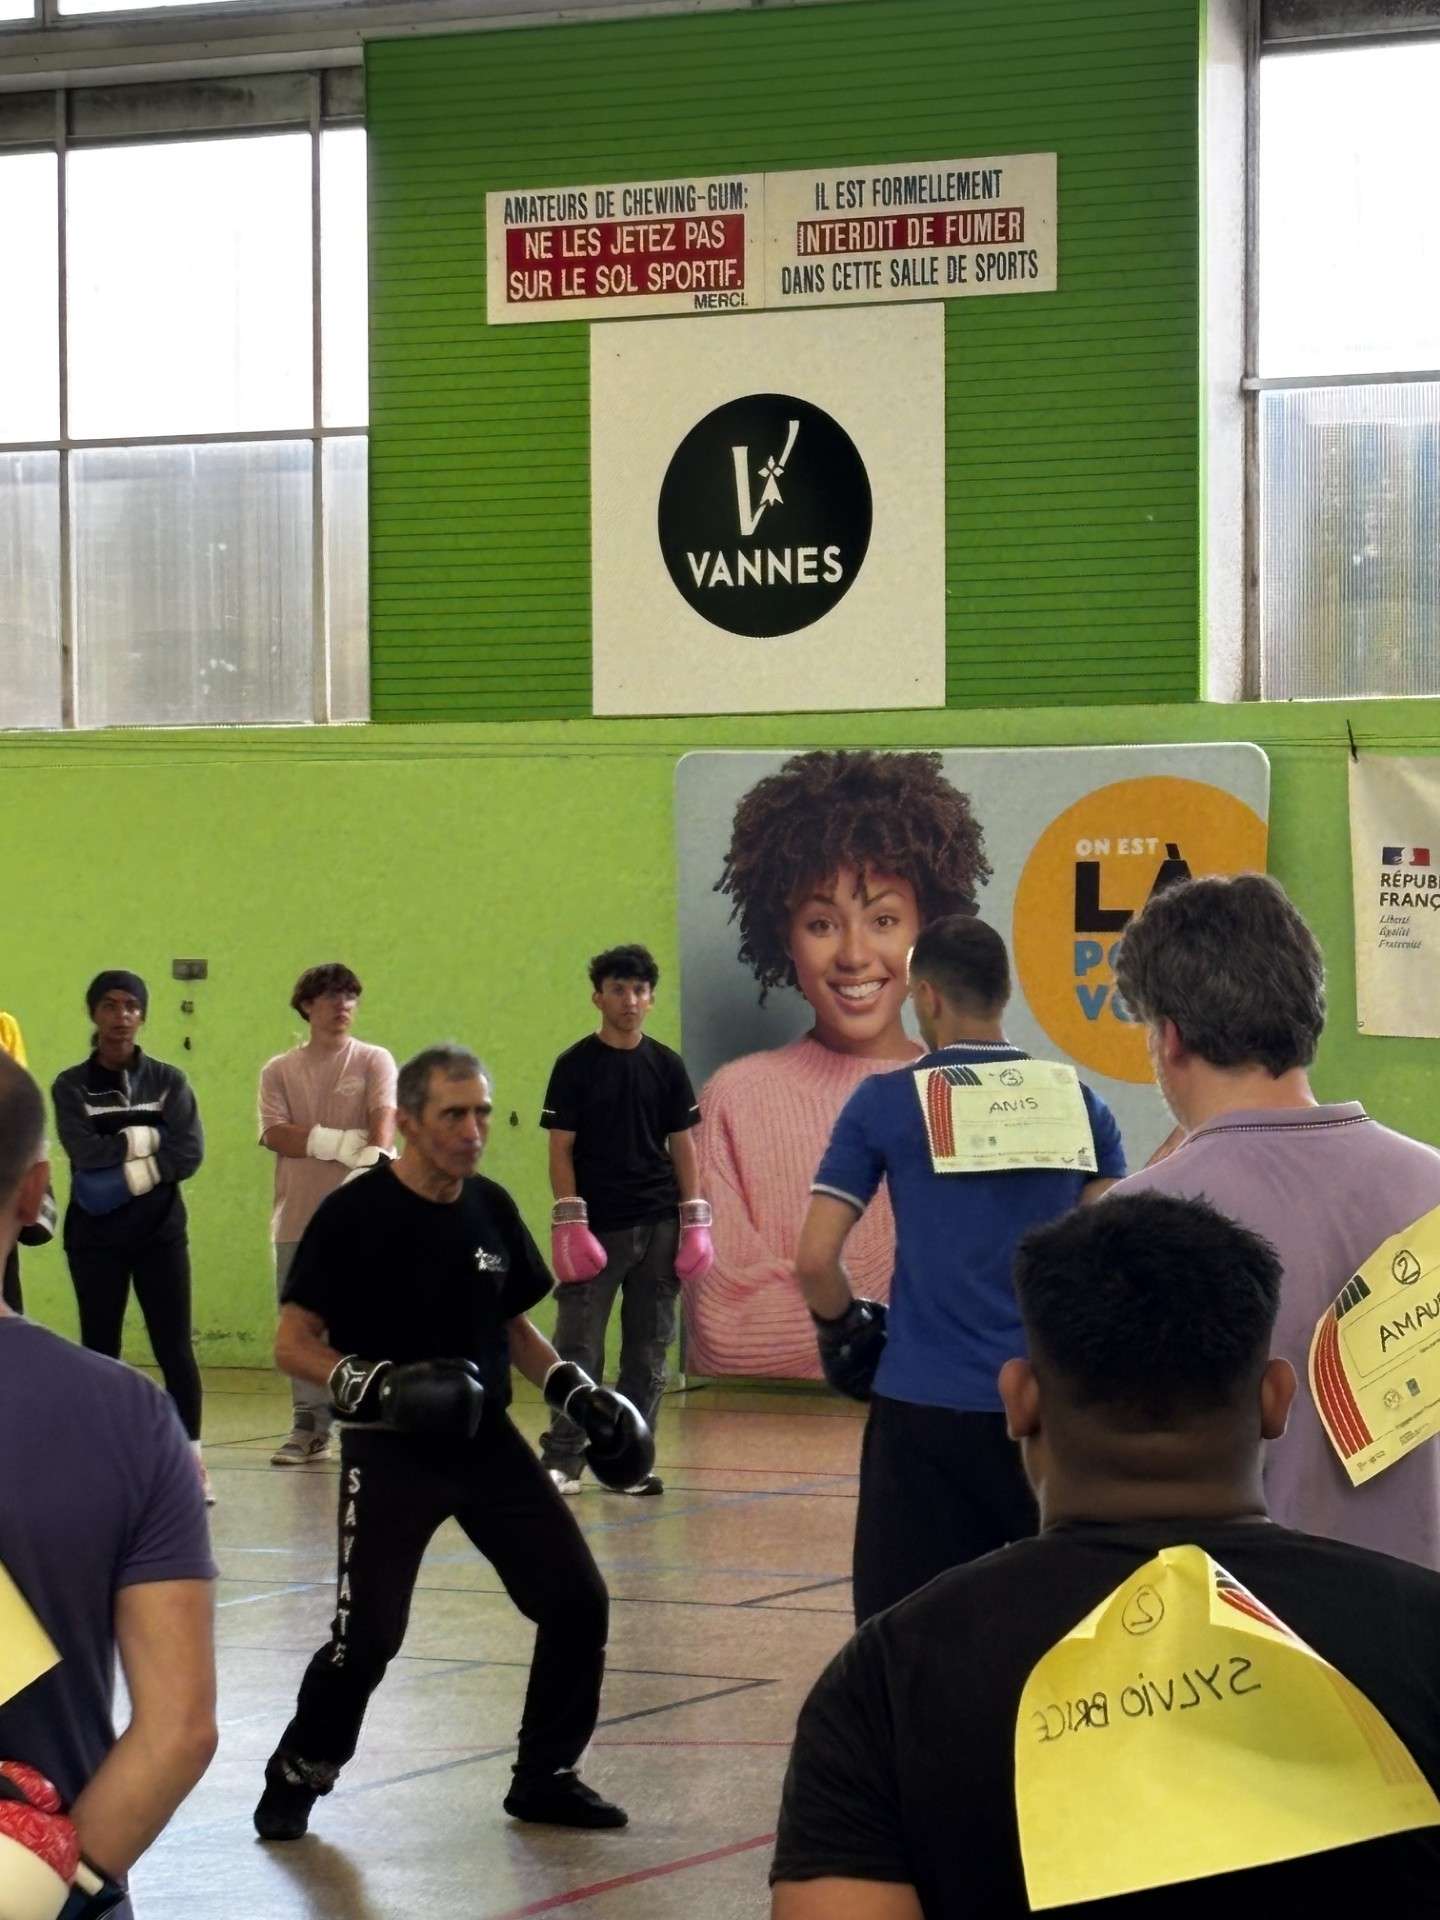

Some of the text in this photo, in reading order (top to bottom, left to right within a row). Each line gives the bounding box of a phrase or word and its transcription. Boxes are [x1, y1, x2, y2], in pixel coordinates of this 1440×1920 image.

[504, 182, 749, 224] AMATEURS DE CHEWING-GUM:
[815, 169, 1003, 211] IL EST FORMELLEMENT
[525, 220, 725, 260] NE LES JETEZ PAS
[798, 211, 1022, 254] INTERDIT DE FUMER
[510, 259, 742, 300] SUR LE SOL SPORTIF.
[781, 249, 1039, 295] DANS CETTE SALLE DE SPORTS
[687, 545, 843, 588] VANNES
[1076, 837, 1159, 857] ON EST
[1380, 870, 1440, 889] RÉPUB
[989, 1097, 1038, 1113] ANIS
[1397, 1256, 1419, 1282] 2
[1380, 1291, 1440, 1352] AMAU
